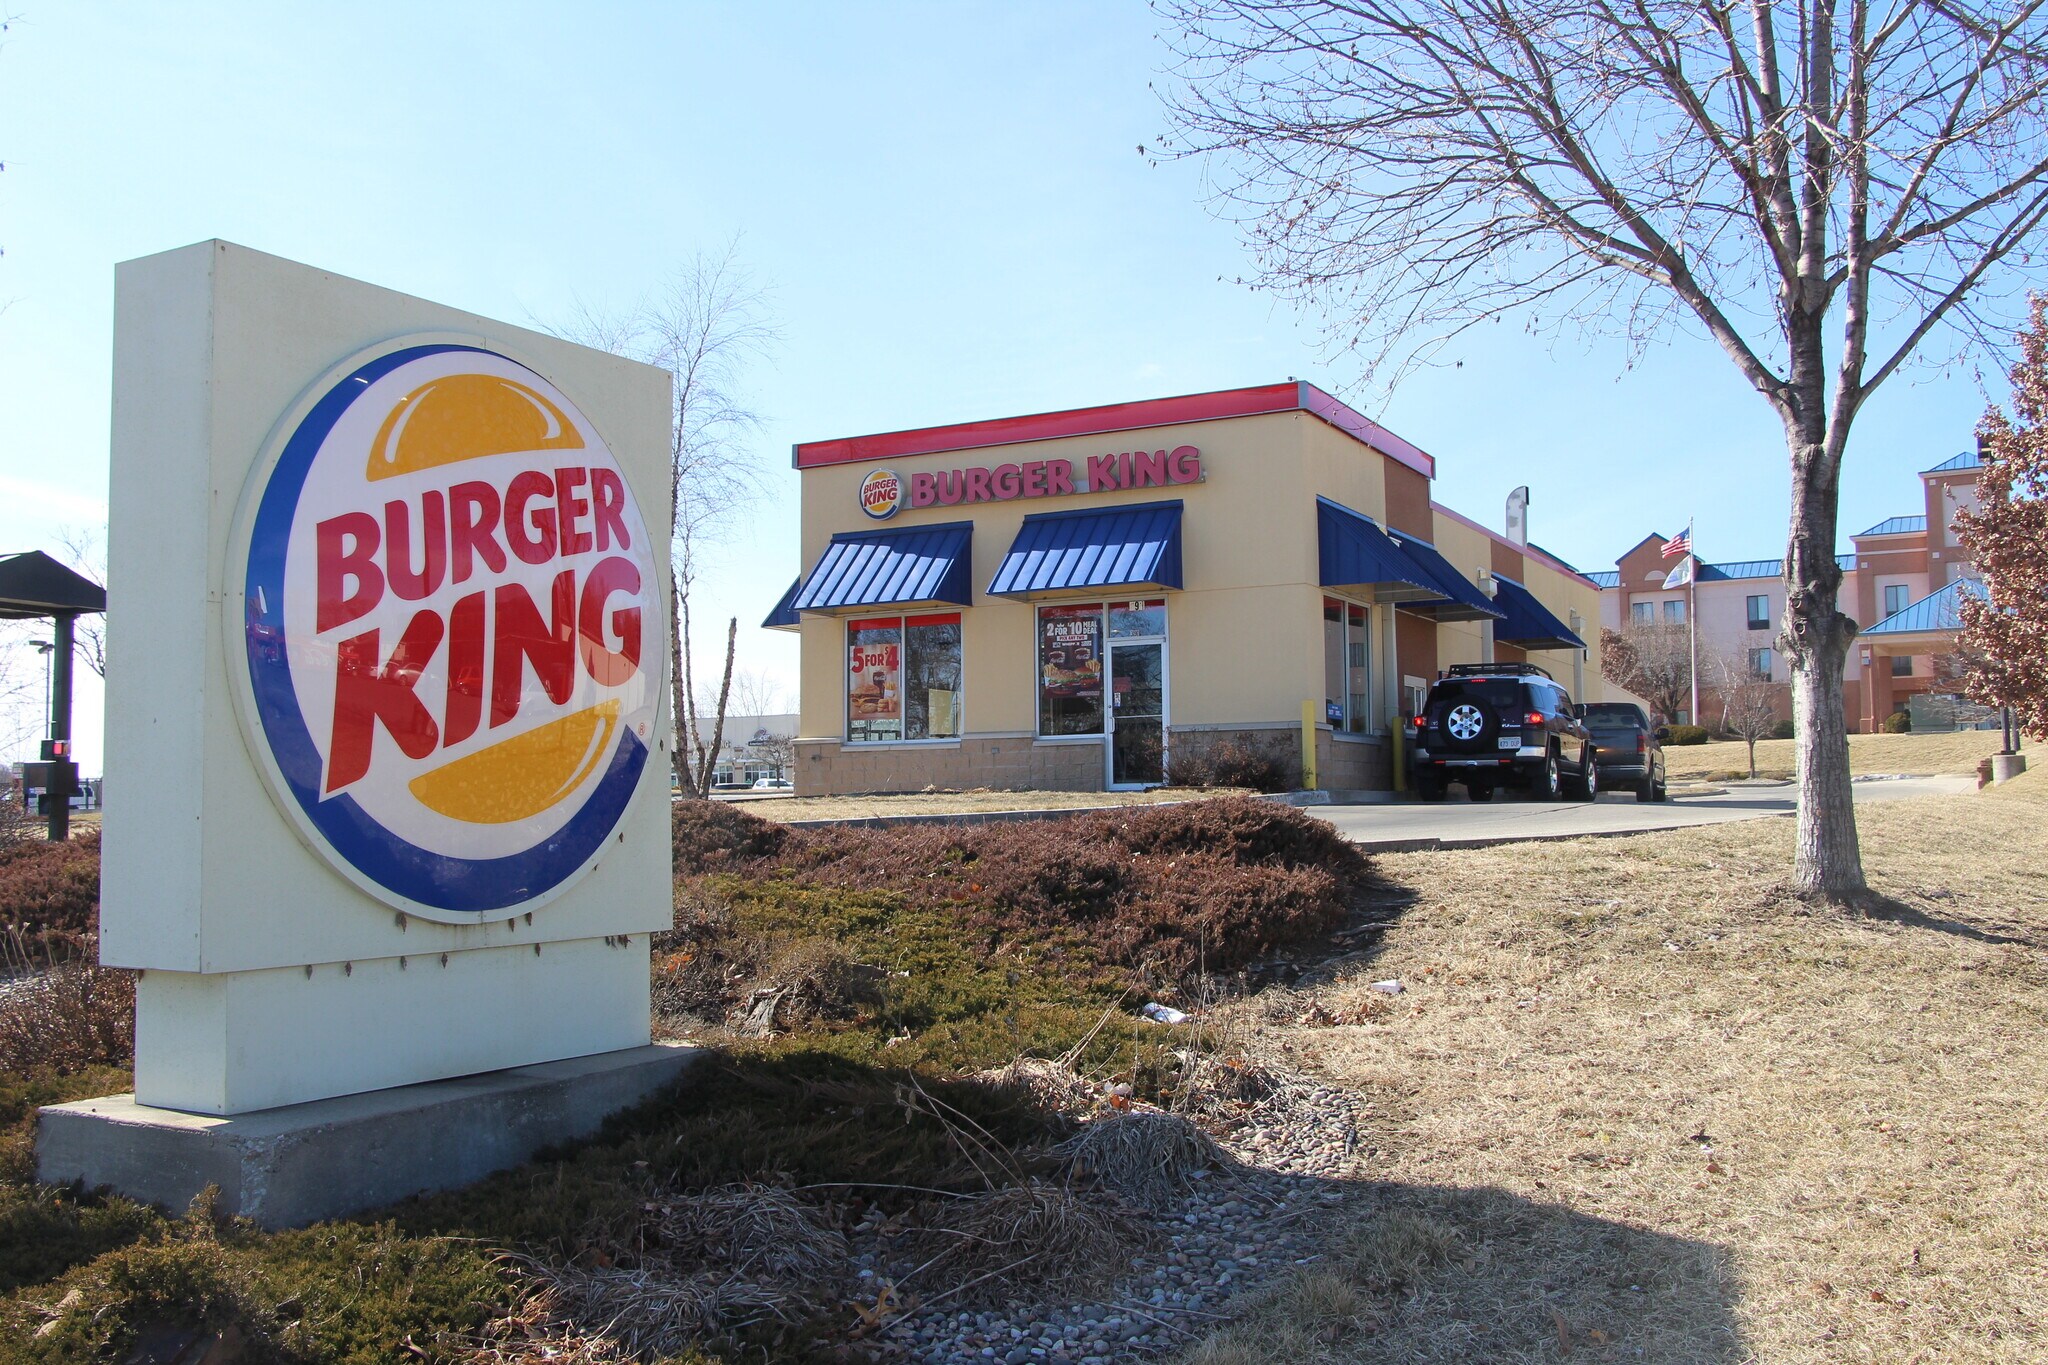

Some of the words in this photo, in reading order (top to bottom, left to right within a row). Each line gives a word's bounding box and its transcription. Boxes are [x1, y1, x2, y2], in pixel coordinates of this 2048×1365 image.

[863, 479, 898, 494] BURGER
[912, 459, 1074, 507] BURGER
[1087, 445, 1200, 492] KING
[863, 488, 898, 507] KING
[316, 467, 631, 635] BURGER
[1047, 622, 1054, 636] 2
[1055, 627, 1067, 635] FOR
[851, 647, 865, 673] 5
[865, 653, 885, 667] FOR
[325, 556, 641, 794] KING
